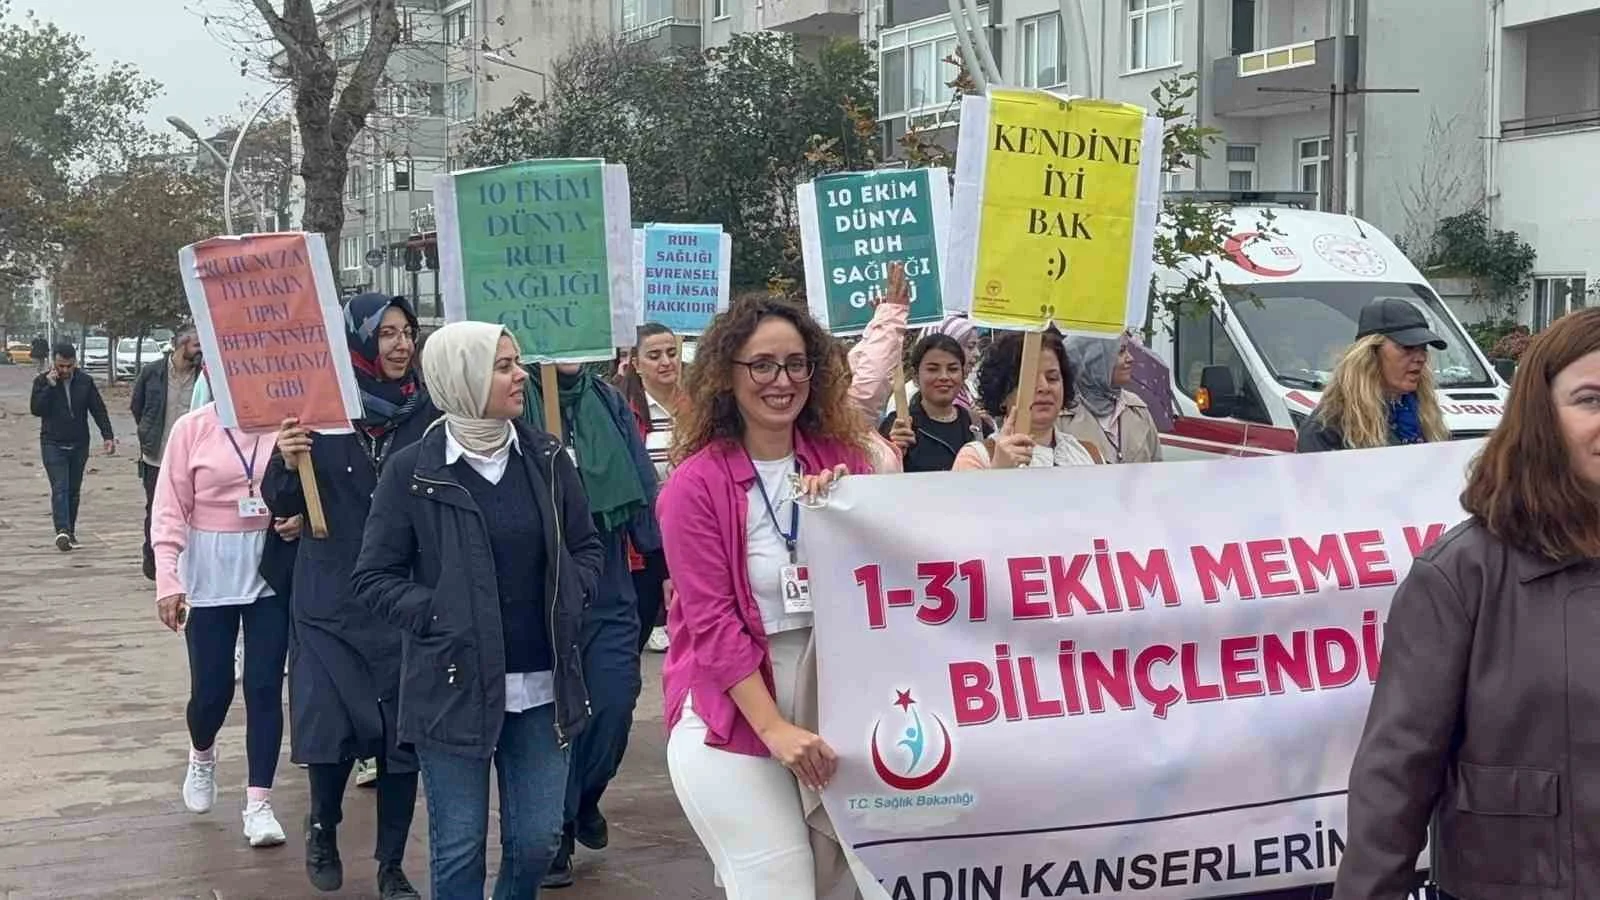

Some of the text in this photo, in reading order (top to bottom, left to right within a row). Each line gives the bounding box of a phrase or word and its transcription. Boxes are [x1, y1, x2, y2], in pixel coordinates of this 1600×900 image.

[993, 123, 1142, 165] KENDİNE
[480, 174, 591, 206] 10 EKİM
[827, 180, 918, 207] 10 EKİM
[1044, 164, 1085, 200] İYİ
[487, 208, 587, 237] DÜNYA
[835, 207, 917, 233] DÜNYA
[1027, 208, 1092, 240] BAK
[668, 235, 697, 246] RUH
[855, 235, 902, 256] RUH
[505, 243, 565, 268] RUH
[656, 249, 712, 264] SAĞLIĞI
[482, 270, 600, 301] SAĞLIĞI
[646, 267, 718, 280] EVRENSEL
[647, 282, 719, 297] BİR İNSAN
[498, 301, 578, 331] GÜNÜ
[647, 300, 716, 313] HAKKIDIR
[266, 375, 305, 399] GİBİ
[854, 559, 987, 630] 1-31
[1008, 538, 1180, 621] EKİM
[1190, 529, 1397, 604] MEME
[875, 796, 913, 810] Sağlık
[916, 792, 974, 807] Bakanlığı
[878, 865, 1004, 900] ADIN
